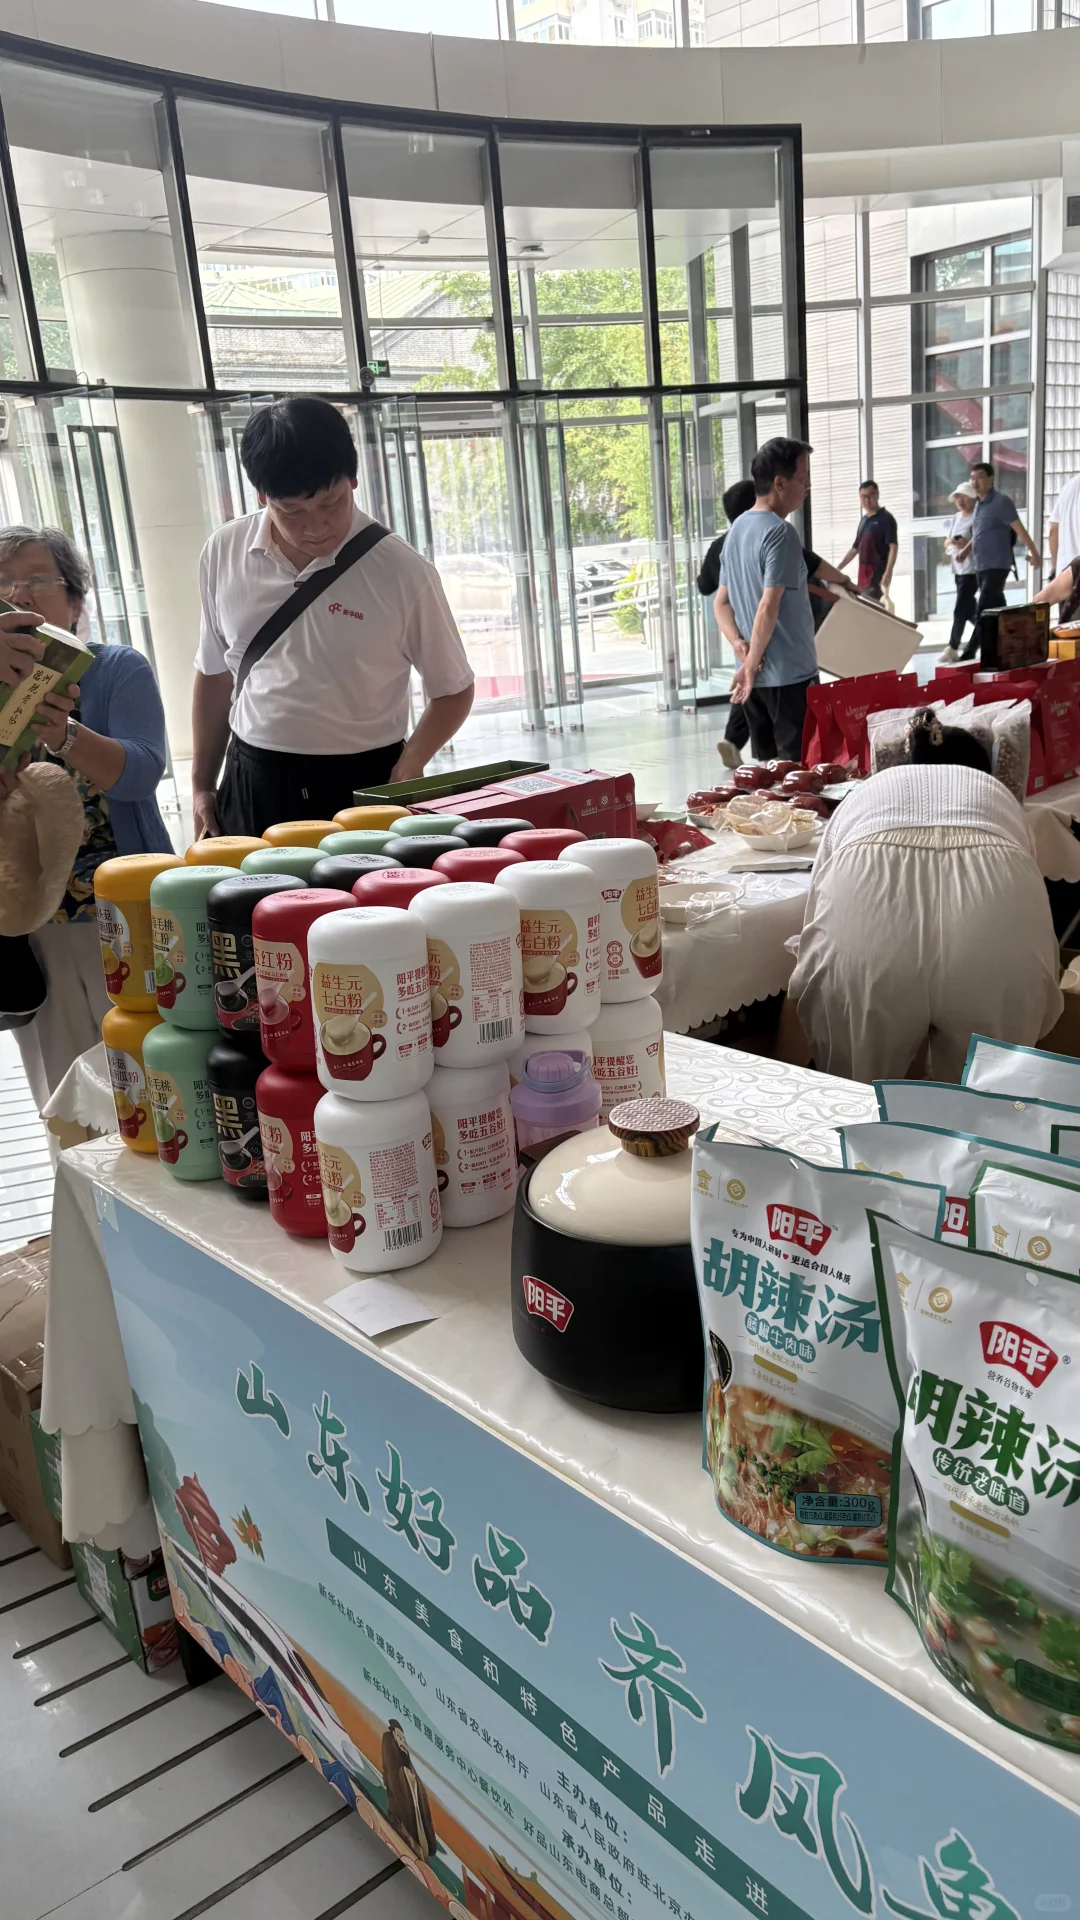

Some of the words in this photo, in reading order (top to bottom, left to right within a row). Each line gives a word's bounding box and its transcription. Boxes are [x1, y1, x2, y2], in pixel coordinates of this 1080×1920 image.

[520, 919, 561, 934] 益生元
[522, 935, 561, 950] 七白粉
[321, 973, 362, 991] 益生元
[397, 964, 429, 986] 阳平提醒
[398, 979, 430, 998] 多吃五谷
[322, 991, 363, 1008] 七白粉
[457, 1107, 503, 1129] 阳平提醒您
[459, 1118, 506, 1141] 多吃五谷好!
[771, 1206, 823, 1246] 阳平
[731, 1228, 782, 1258] 专为中国人研制
[790, 1255, 851, 1285] 更适合国人体质
[528, 1281, 566, 1321] 阳平
[703, 1237, 881, 1353] 胡辣汤
[745, 1315, 815, 1361] 藤椒牛肉味
[987, 1324, 1049, 1376] 阳平
[987, 1369, 1034, 1400] 营养谷物专家
[935, 1450, 1027, 1513] 传统老味道
[235, 1359, 556, 1646] 山东好品
[801, 1495, 876, 1511] 净含量:300g
[318, 1582, 428, 1687] 新华社机关管理服务中心
[435, 1688, 530, 1779] 山东省农业农村厅
[363, 1667, 515, 1820] 新华社机关管理服务中心餐饮处
